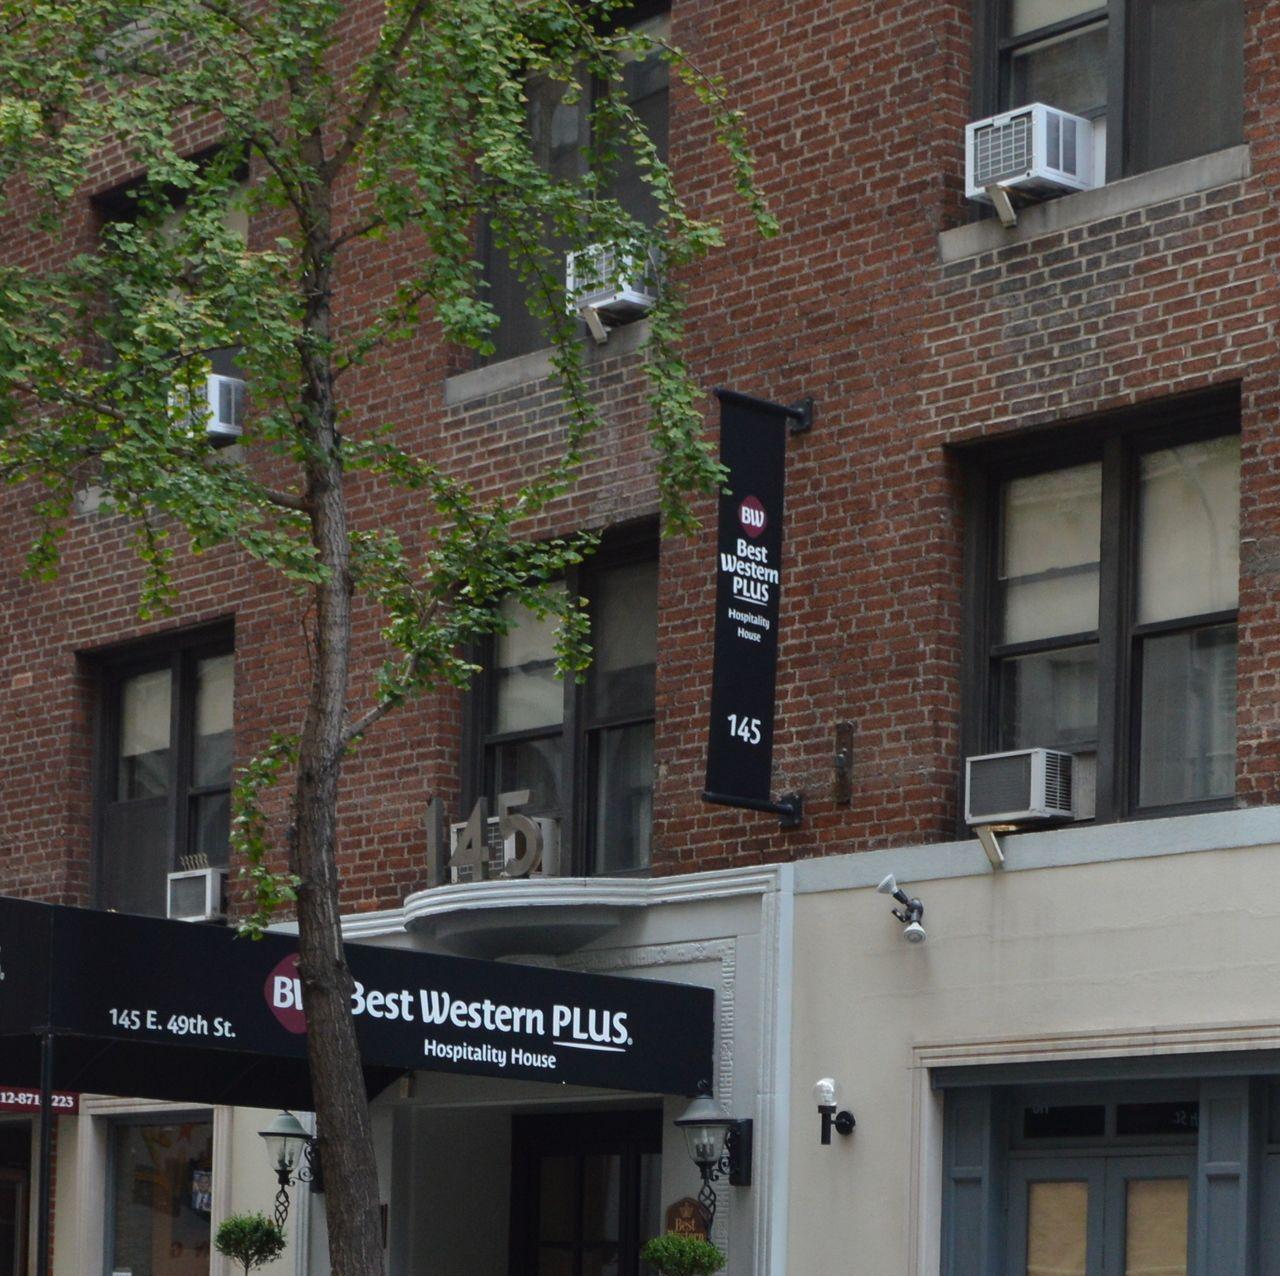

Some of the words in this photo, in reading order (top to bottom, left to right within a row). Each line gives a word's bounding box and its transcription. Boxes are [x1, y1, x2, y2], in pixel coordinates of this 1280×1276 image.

[741, 506, 764, 527] BW
[737, 538, 768, 563] Best
[721, 552, 779, 584] Western
[733, 576, 769, 602] PLUS
[728, 607, 771, 630] Hospitality
[737, 627, 762, 642] House
[727, 713, 761, 745] 145
[423, 789, 544, 888] 145
[273, 976, 303, 1010] B
[109, 1008, 140, 1030] 145
[146, 1010, 162, 1030] E.
[167, 1015, 208, 1036] 49th
[213, 1017, 236, 1038] St.
[420, 989, 545, 1036] Western
[552, 1004, 628, 1046] PLUS
[424, 1039, 507, 1067] Hospitality
[511, 1048, 556, 1068] House
